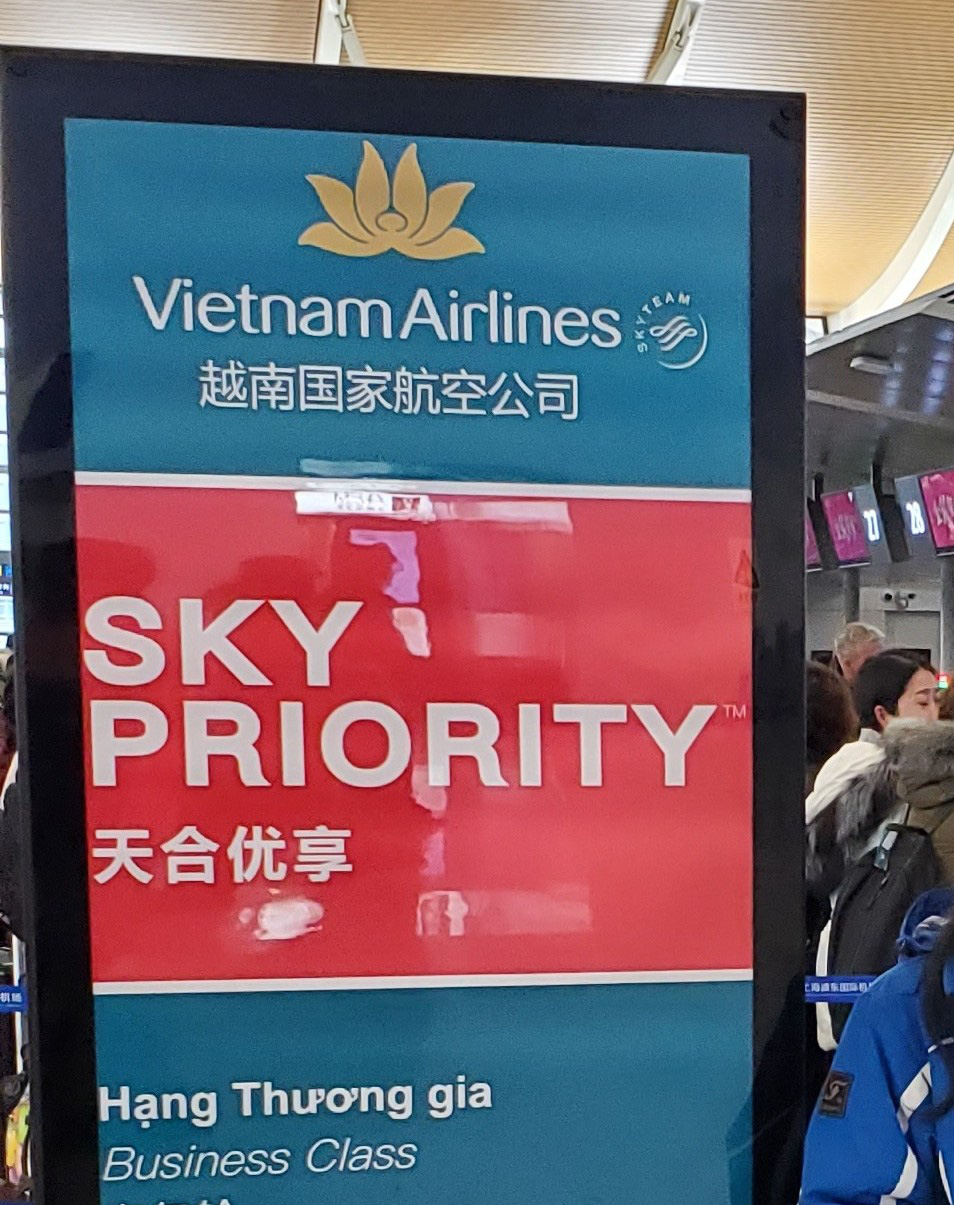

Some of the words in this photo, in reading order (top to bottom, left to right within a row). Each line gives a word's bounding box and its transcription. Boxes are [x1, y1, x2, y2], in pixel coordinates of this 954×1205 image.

[132, 276, 392, 339] Vietnam
[401, 288, 622, 349] Airlines
[634, 291, 691, 353] SKYTEAM
[198, 360, 580, 420] 越南国家航空公司
[905, 501, 926, 535] 28
[83, 596, 363, 687] SKY
[90, 700, 717, 788] PRIORITY
[93, 824, 353, 886] 天合优享
[99, 1084, 218, 1130] Hạng
[231, 1080, 412, 1121] Thương
[428, 1075, 493, 1119] gia
[103, 1145, 290, 1183] Business
[306, 1139, 417, 1174] Class
